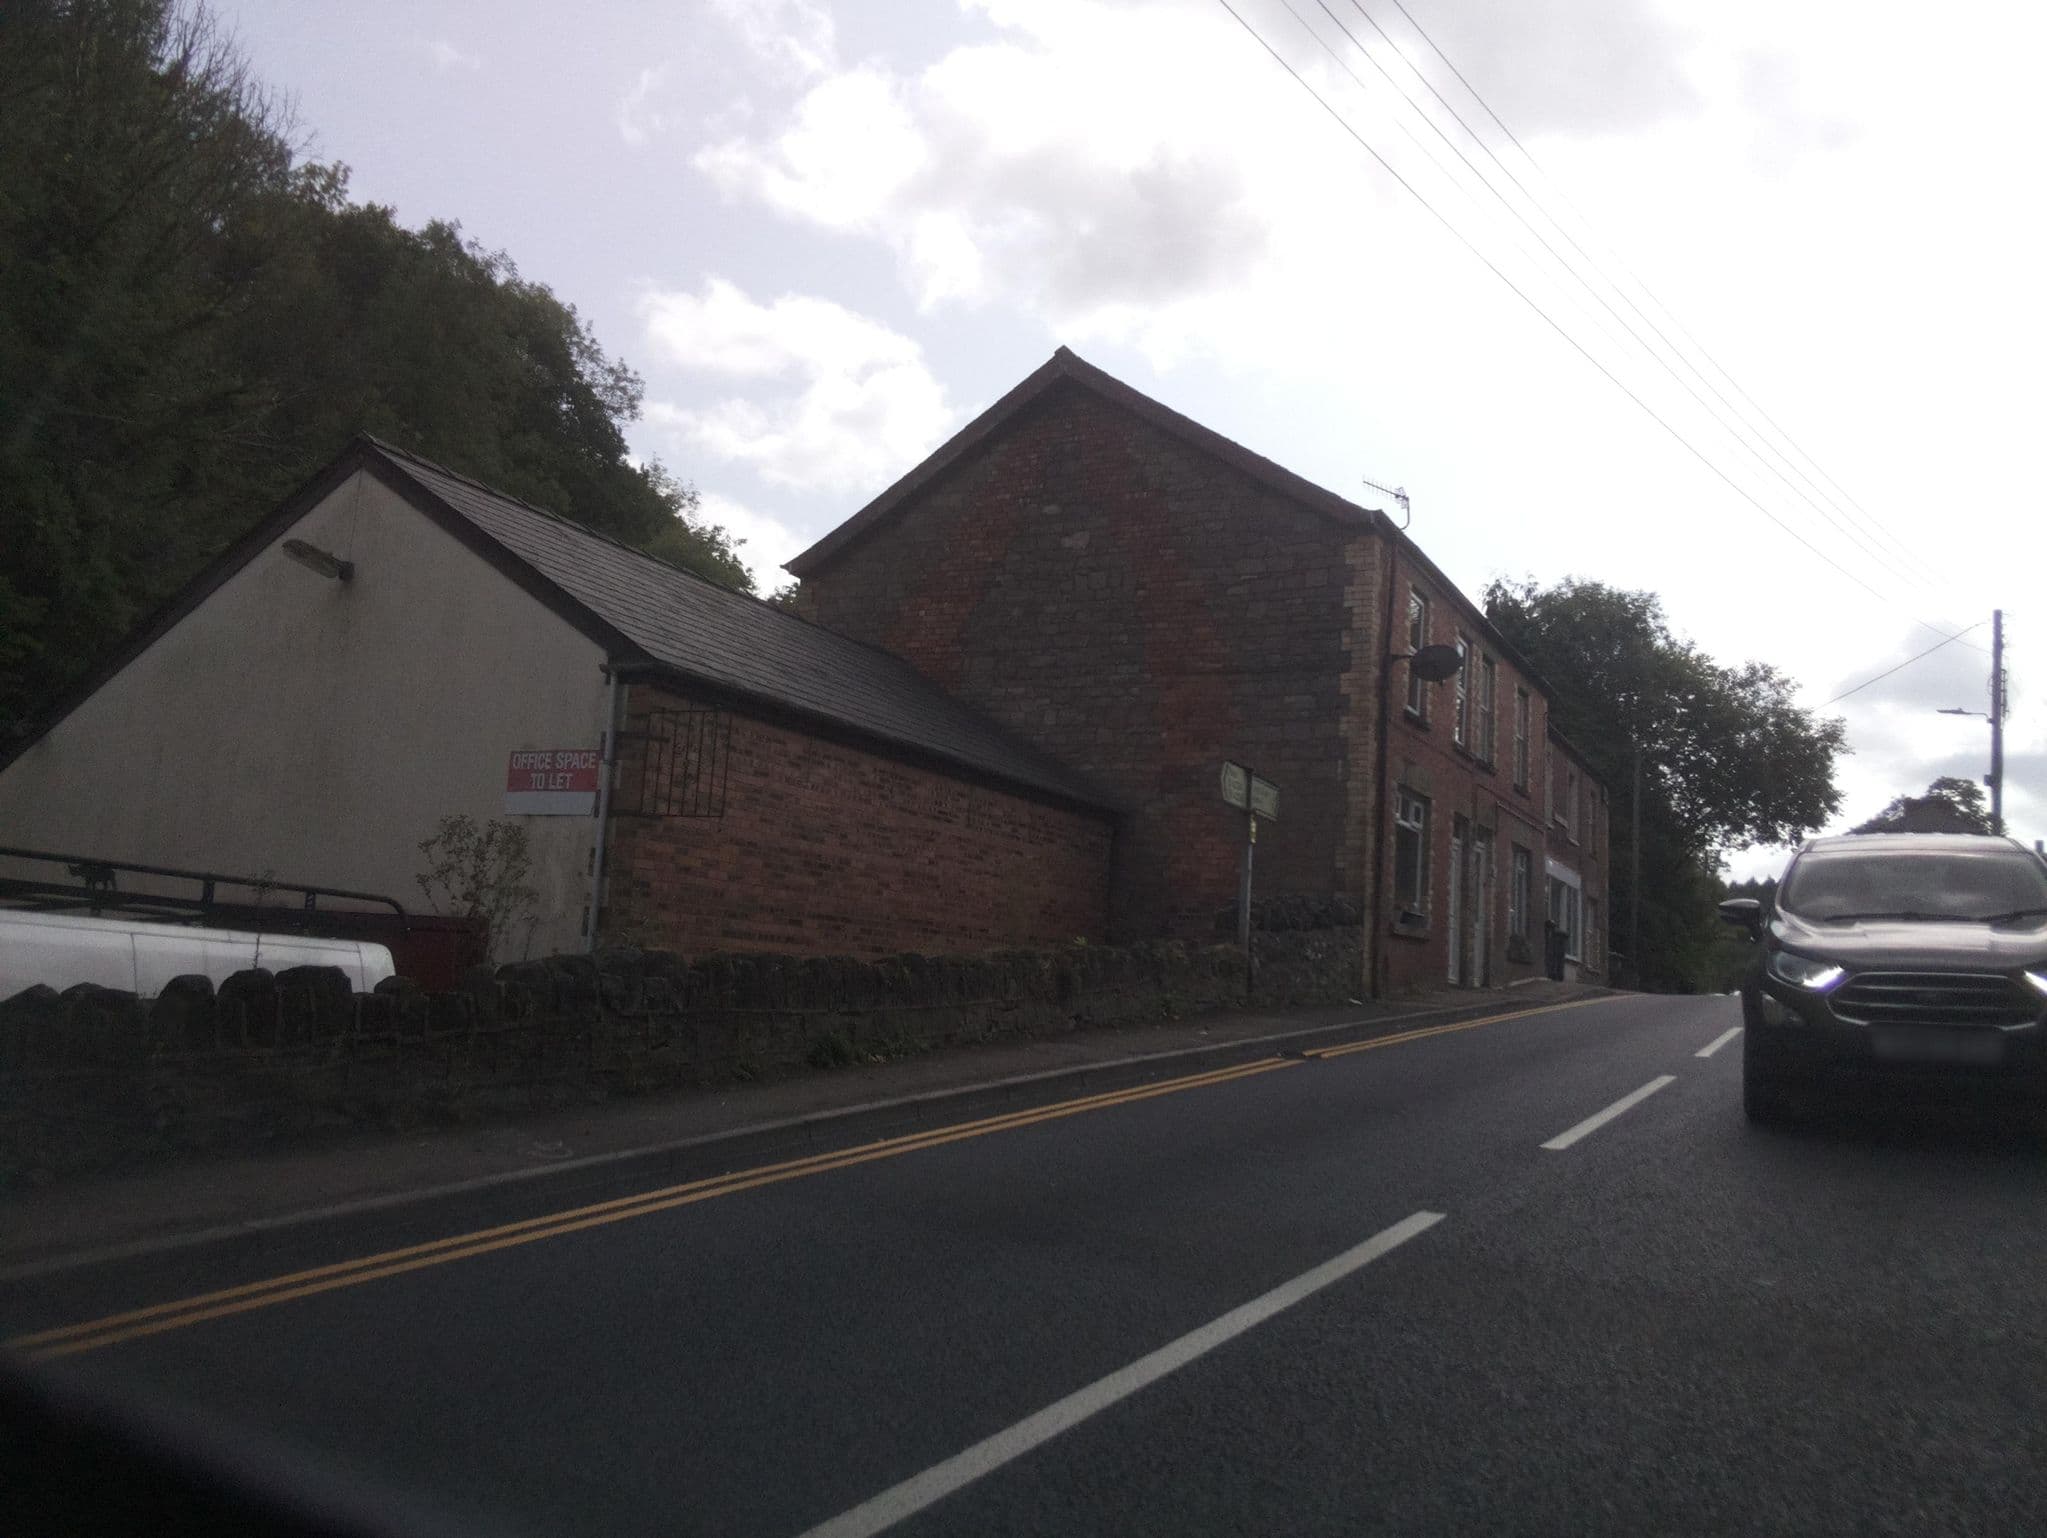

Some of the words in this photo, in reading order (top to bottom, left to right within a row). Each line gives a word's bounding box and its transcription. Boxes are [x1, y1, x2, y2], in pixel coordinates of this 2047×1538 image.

[512, 752, 552, 769] OFFICE
[556, 752, 597, 769] SPACE
[531, 773, 545, 789] TO
[549, 773, 574, 789] LET
